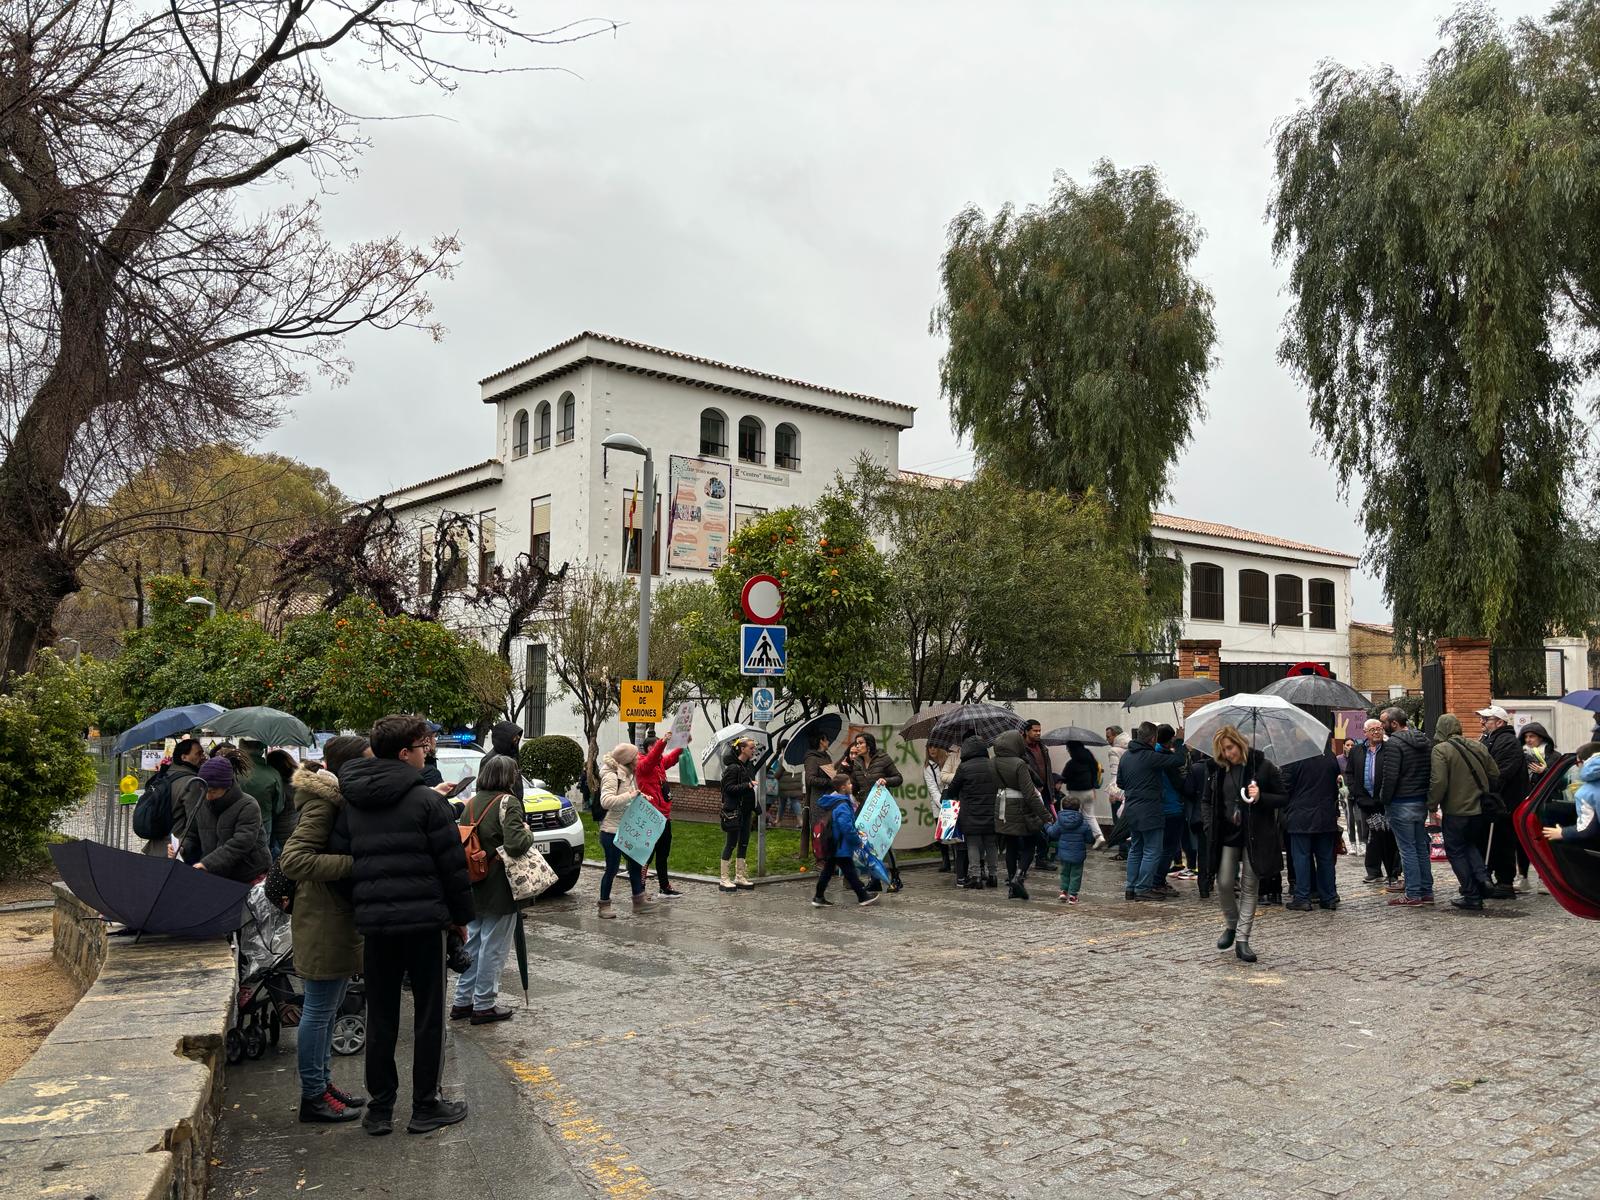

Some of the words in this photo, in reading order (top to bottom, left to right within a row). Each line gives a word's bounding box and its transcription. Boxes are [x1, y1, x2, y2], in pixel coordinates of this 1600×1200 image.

[632, 685, 653, 693] SALIDA
[638, 697, 647, 705] DE
[626, 708, 657, 717] CAMIONES
[868, 801, 891, 838] COCHES
